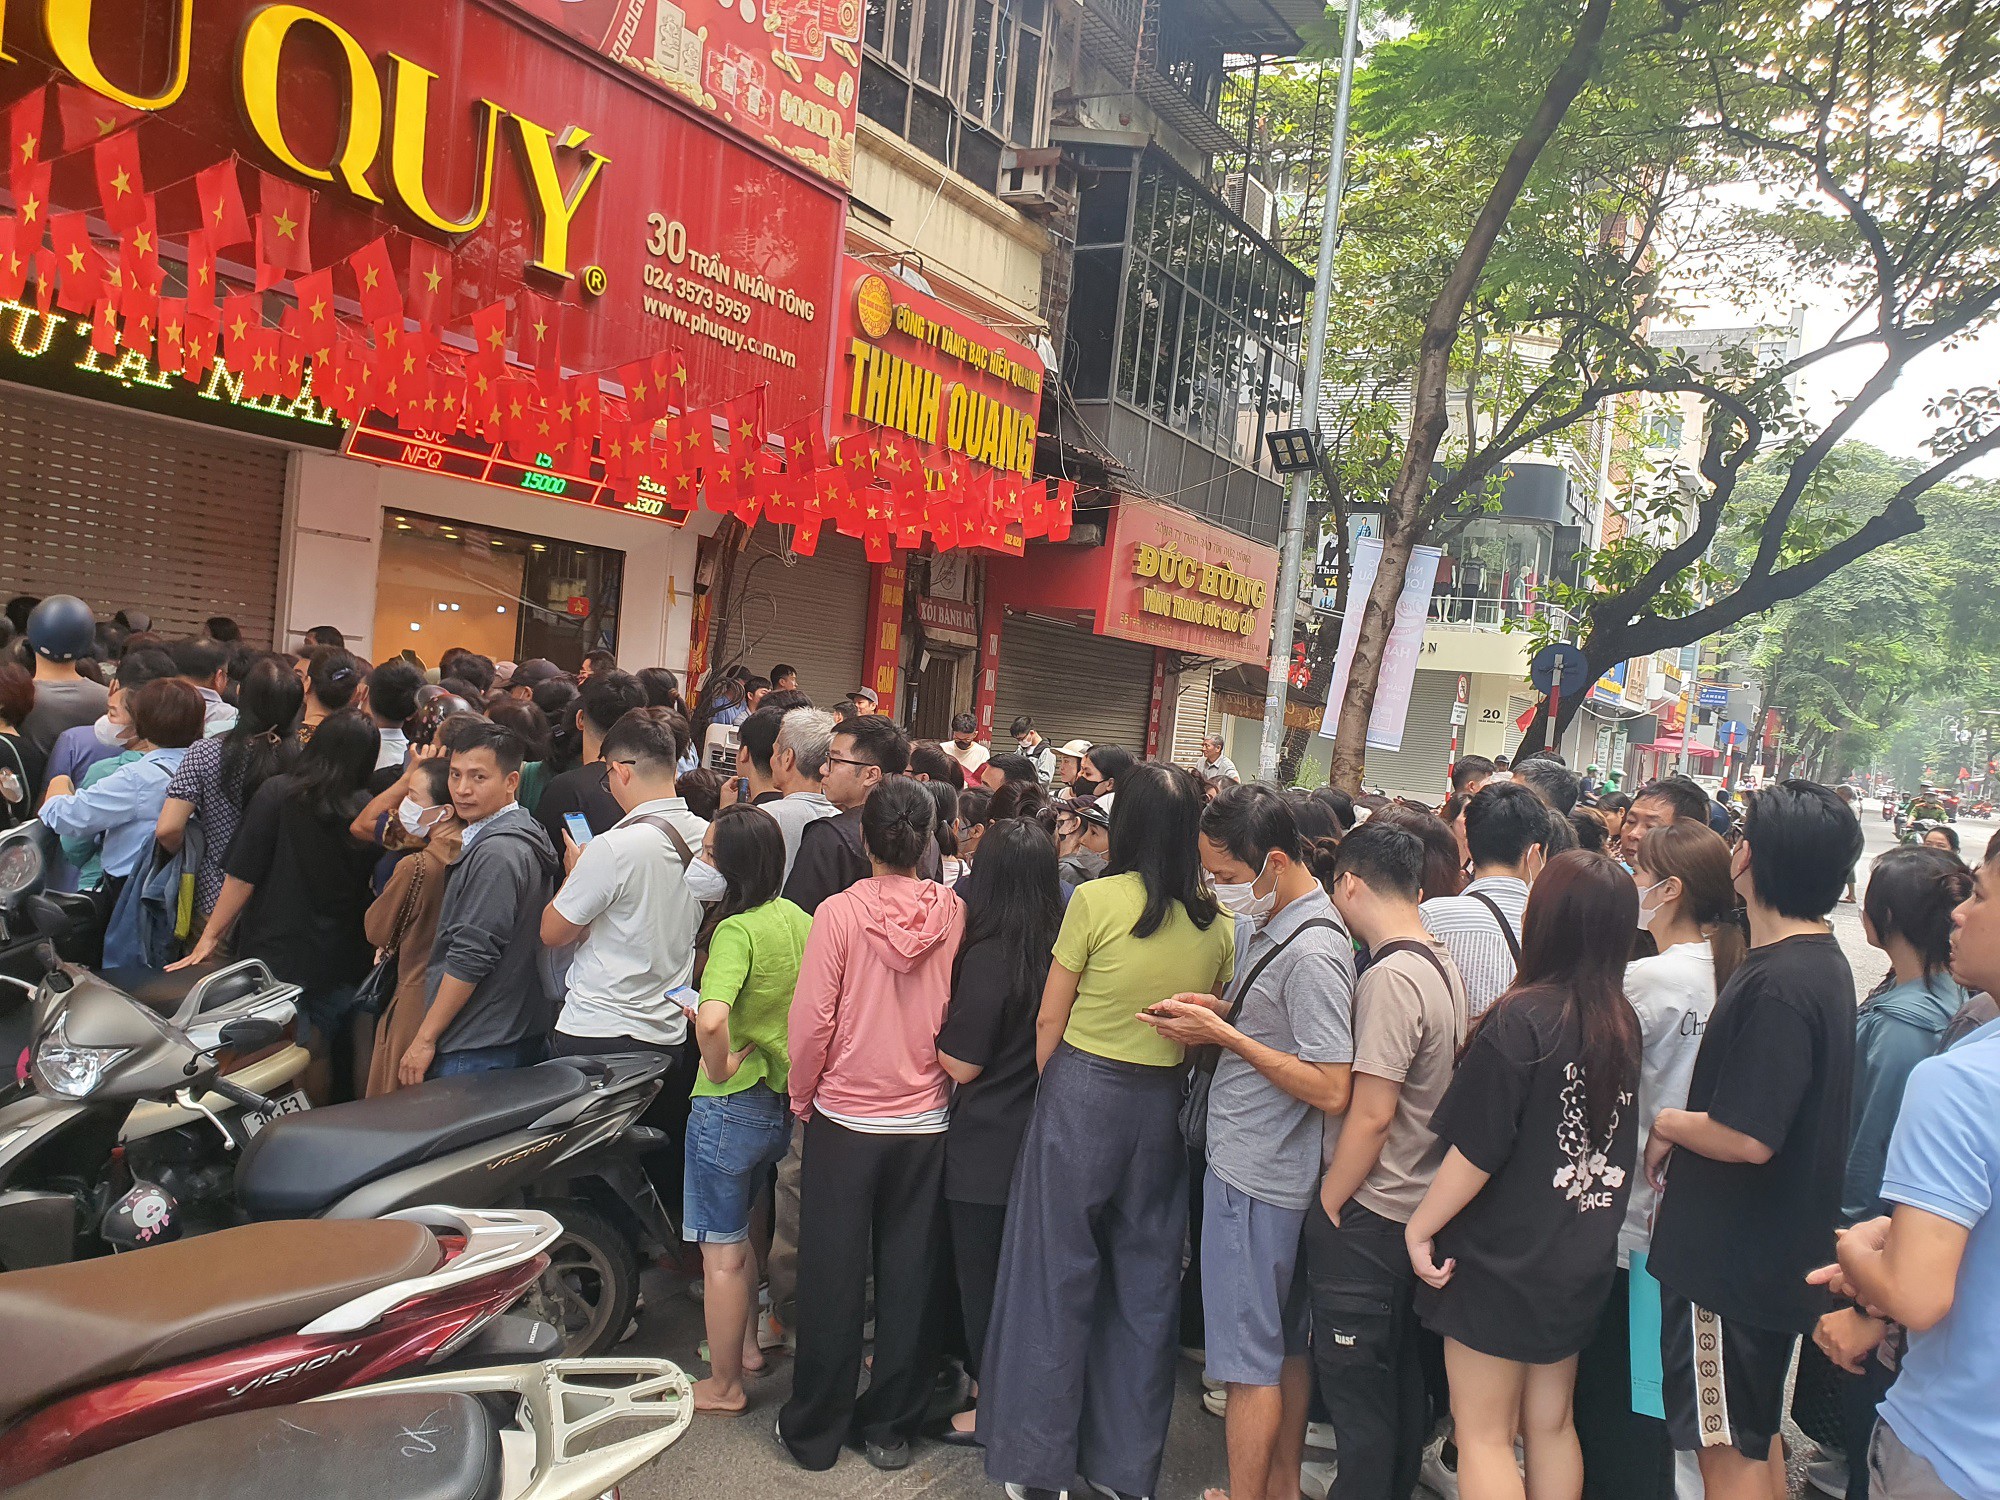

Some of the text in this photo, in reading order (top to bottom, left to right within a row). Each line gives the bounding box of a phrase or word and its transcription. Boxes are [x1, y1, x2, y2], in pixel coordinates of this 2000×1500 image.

[242, 4, 612, 281] QUÝ
[643, 264, 752, 324] 024 3573 5959
[646, 212, 815, 321] 30 TRẦN NHÂN TÔNG
[643, 295, 796, 368] www.phuquy.com.vn
[896, 304, 925, 341] CÔNG
[926, 320, 941, 347] TY
[940, 326, 968, 365] VÀNG
[968, 342, 988, 371] BẠC
[1011, 362, 1040, 395] QUANG
[947, 382, 1036, 475] QUANG
[401, 444, 442, 469] NPQ
[520, 471, 567, 494] 15000
[1136, 541, 1267, 609] ĐỨC HÙNG
[920, 600, 937, 621] XÔI
[938, 603, 962, 627] BÁNH
[1143, 585, 1171, 617] VÀNG
[1173, 595, 1204, 624] TRANG
[1222, 608, 1239, 633] CAO
[1240, 609, 1256, 636] CẤP
[1483, 708, 1500, 719] 20
[486, 1133, 567, 1170] VISION
[528, 1321, 540, 1345] HONDA
[227, 1344, 362, 1397] VISION
